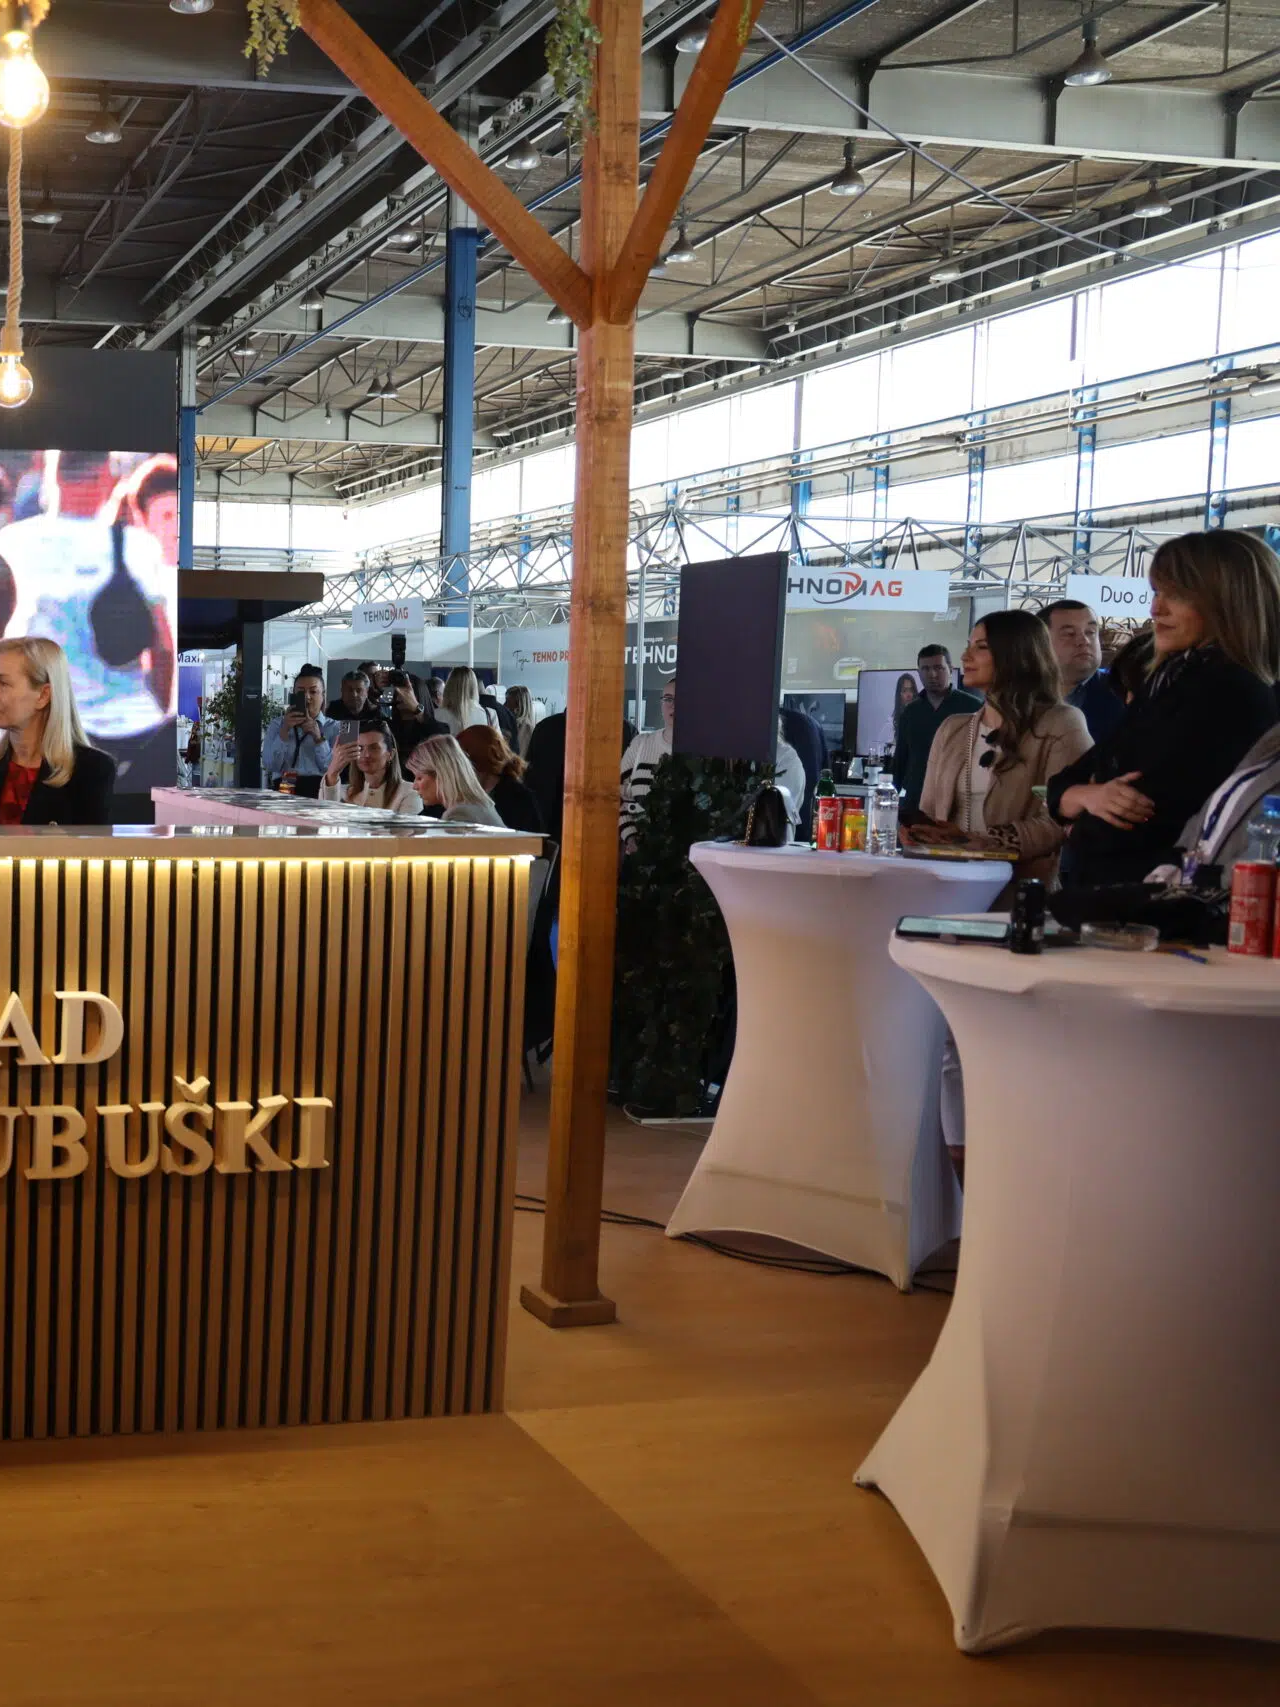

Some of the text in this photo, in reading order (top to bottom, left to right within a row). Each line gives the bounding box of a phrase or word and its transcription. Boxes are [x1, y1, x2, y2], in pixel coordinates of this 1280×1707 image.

[787, 577, 904, 597] HNOMAG
[1100, 585, 1151, 605] Duo d.
[363, 606, 409, 623] TEHNOMAG
[532, 651, 558, 664] TEHNO
[624, 644, 678, 664] TEHNO
